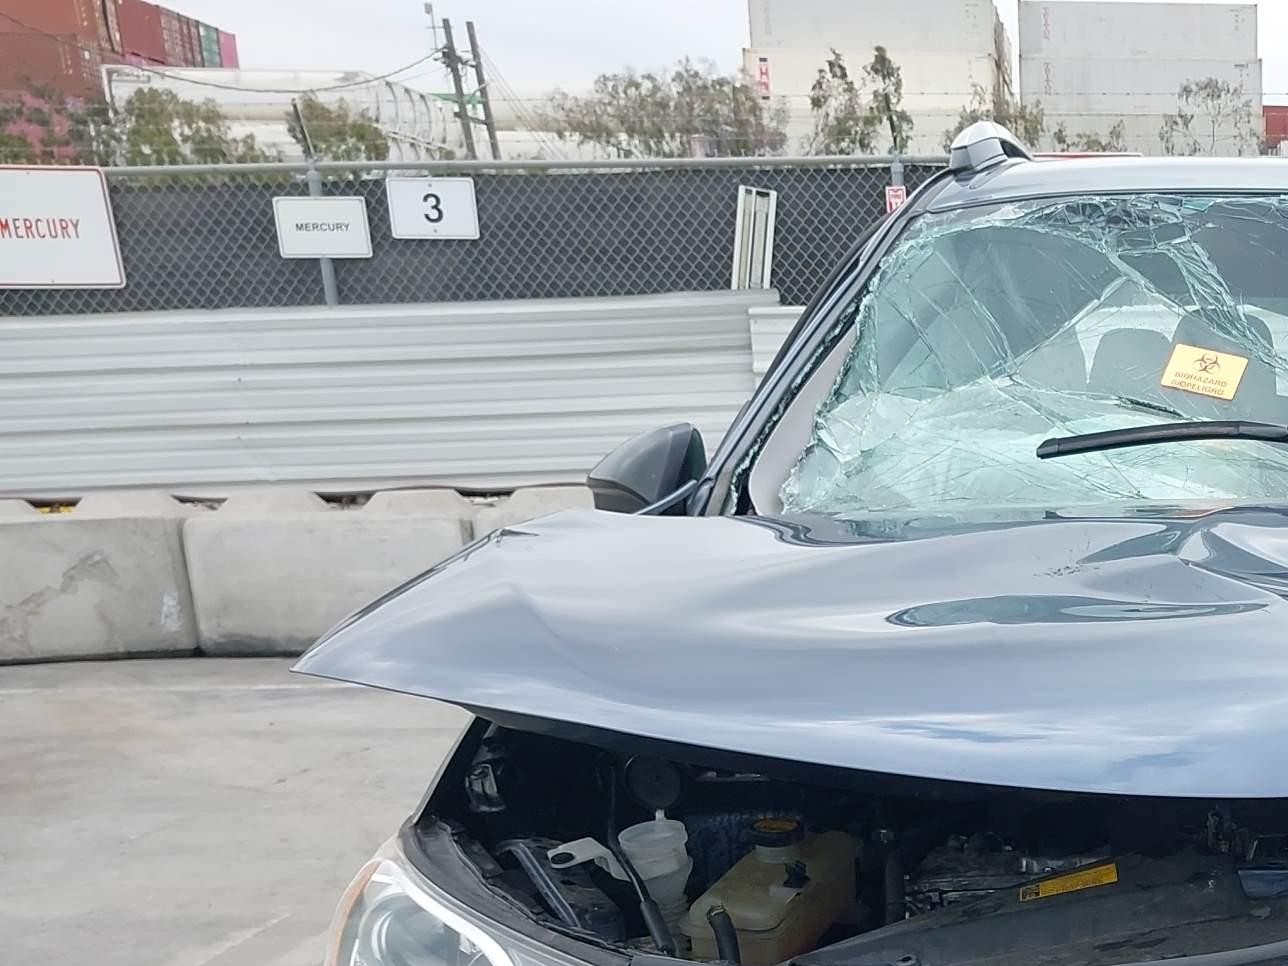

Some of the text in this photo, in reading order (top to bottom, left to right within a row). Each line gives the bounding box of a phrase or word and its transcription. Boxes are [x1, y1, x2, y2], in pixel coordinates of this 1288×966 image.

[422, 193, 444, 224] 3
[0, 218, 80, 239] MERCURY
[295, 222, 350, 232] MERCURY
[1174, 371, 1228, 388] BIOHAZARD
